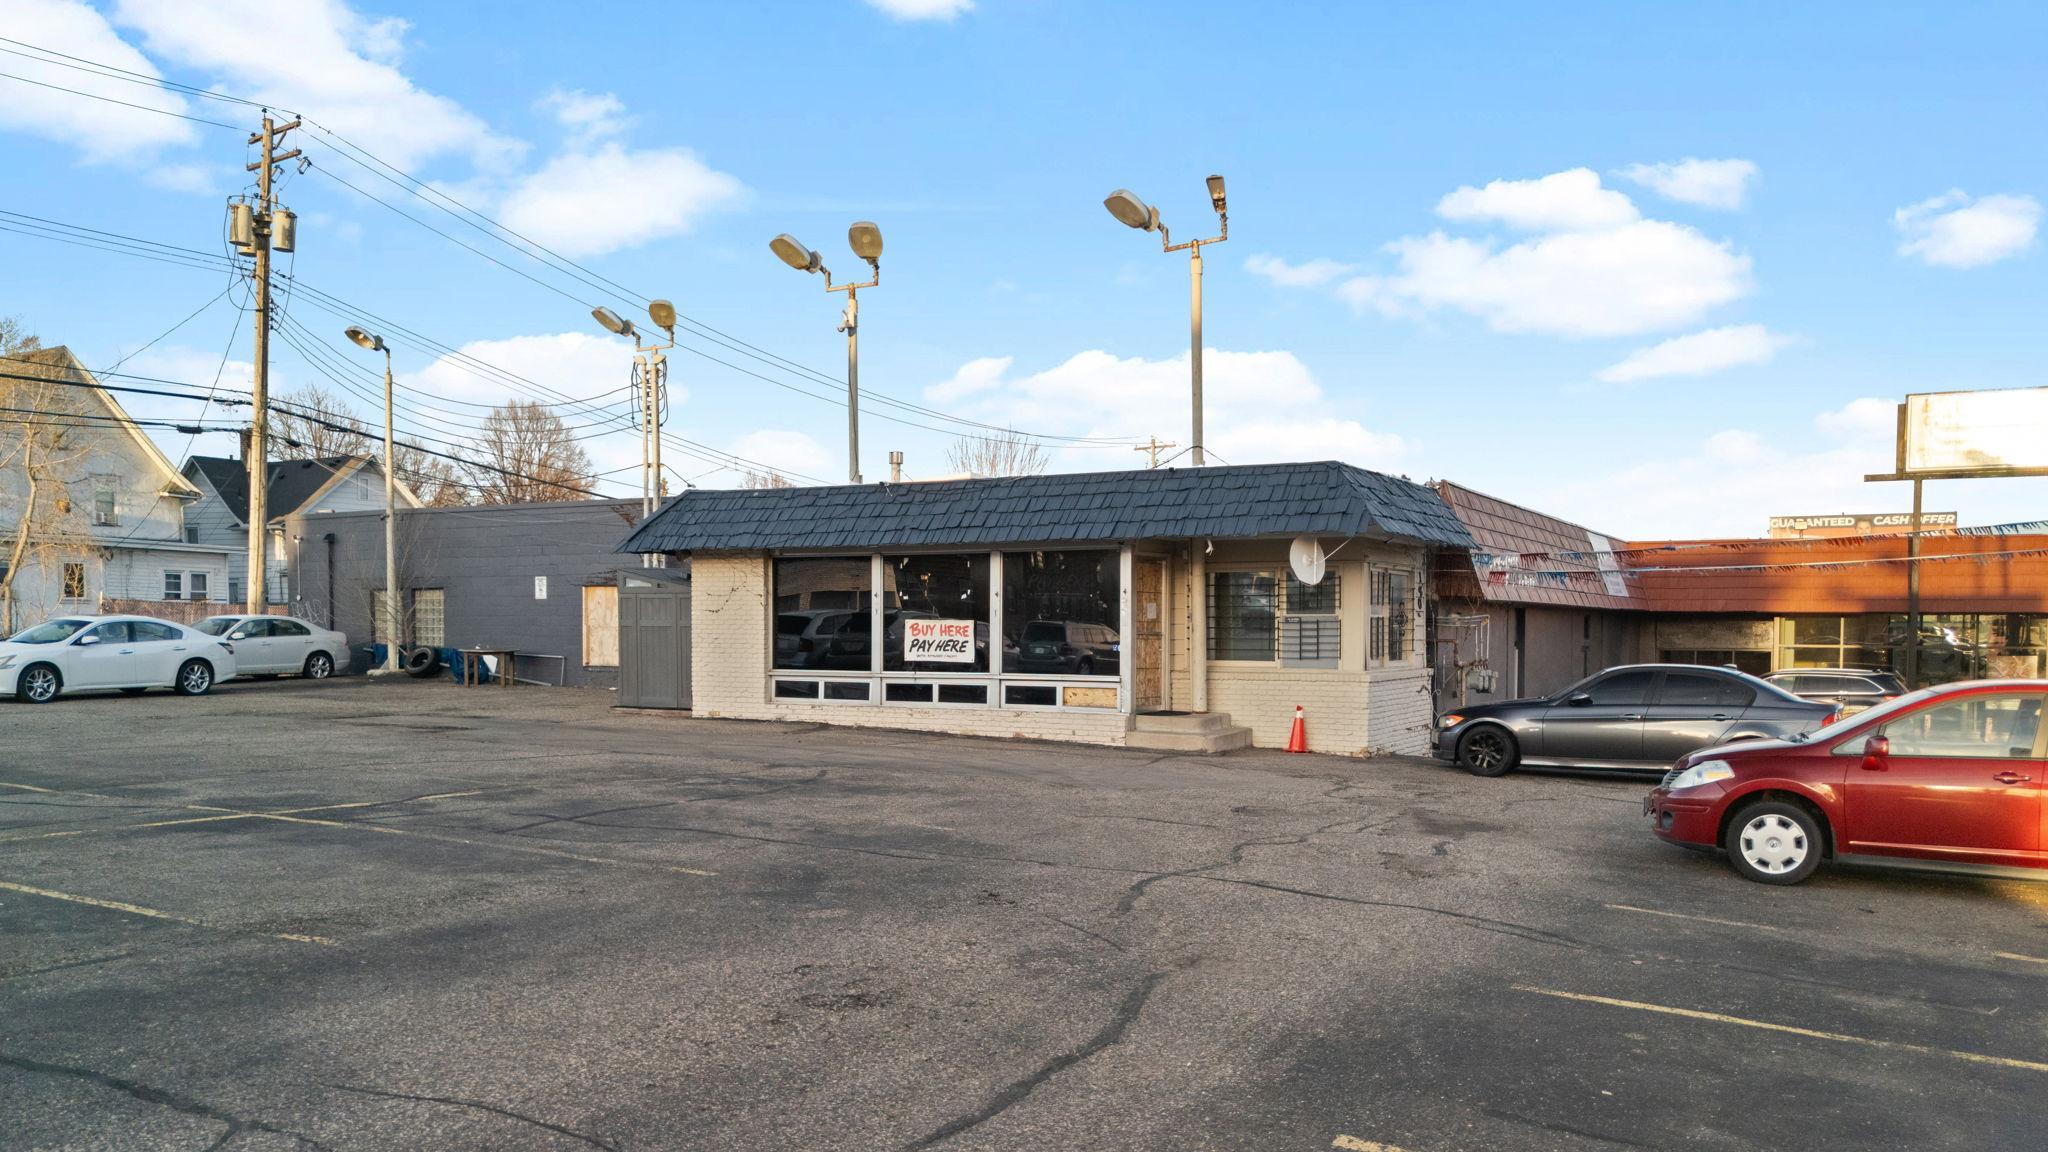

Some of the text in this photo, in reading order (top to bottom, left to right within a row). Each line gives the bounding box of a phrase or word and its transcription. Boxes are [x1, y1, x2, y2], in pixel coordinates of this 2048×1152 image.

[1873, 515, 1910, 525] CASH
[1911, 514, 1956, 524] FFER
[909, 622, 969, 638] BUY HERE
[909, 638, 969, 653] PAY HERE
